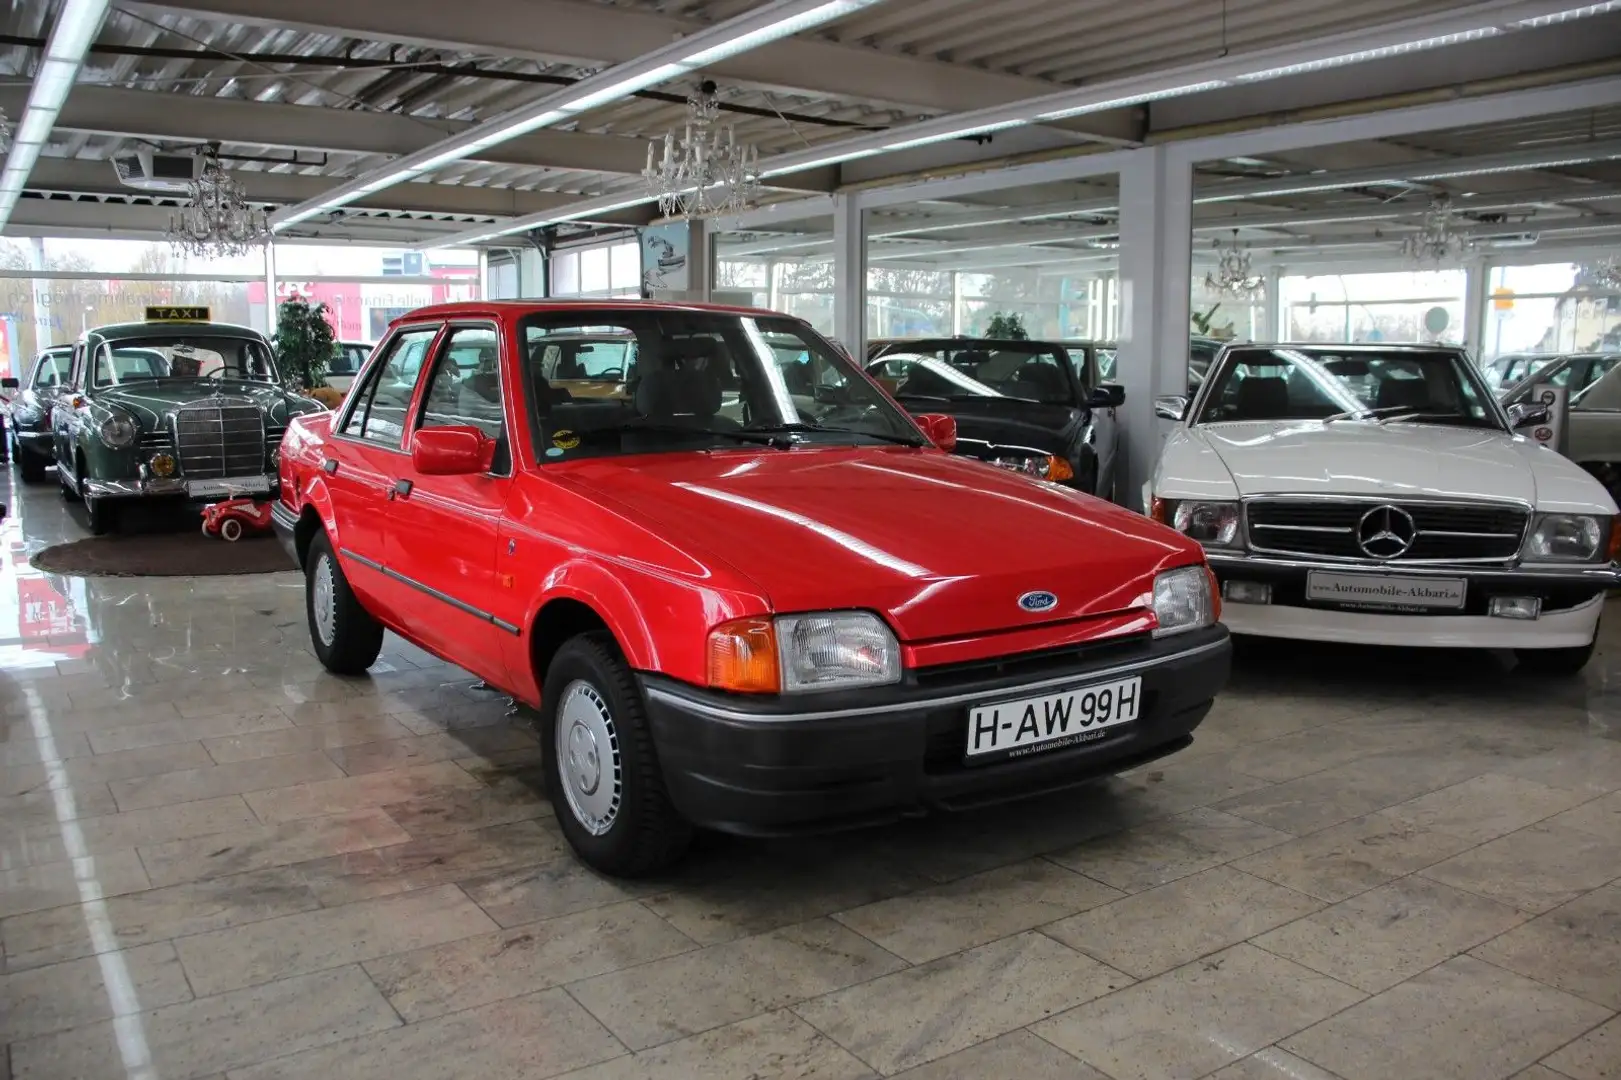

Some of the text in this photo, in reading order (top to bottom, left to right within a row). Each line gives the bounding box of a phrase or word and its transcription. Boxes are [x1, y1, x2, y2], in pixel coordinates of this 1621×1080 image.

[155, 308, 200, 318] TAXI
[974, 682, 1137, 750] H-AW 99H
